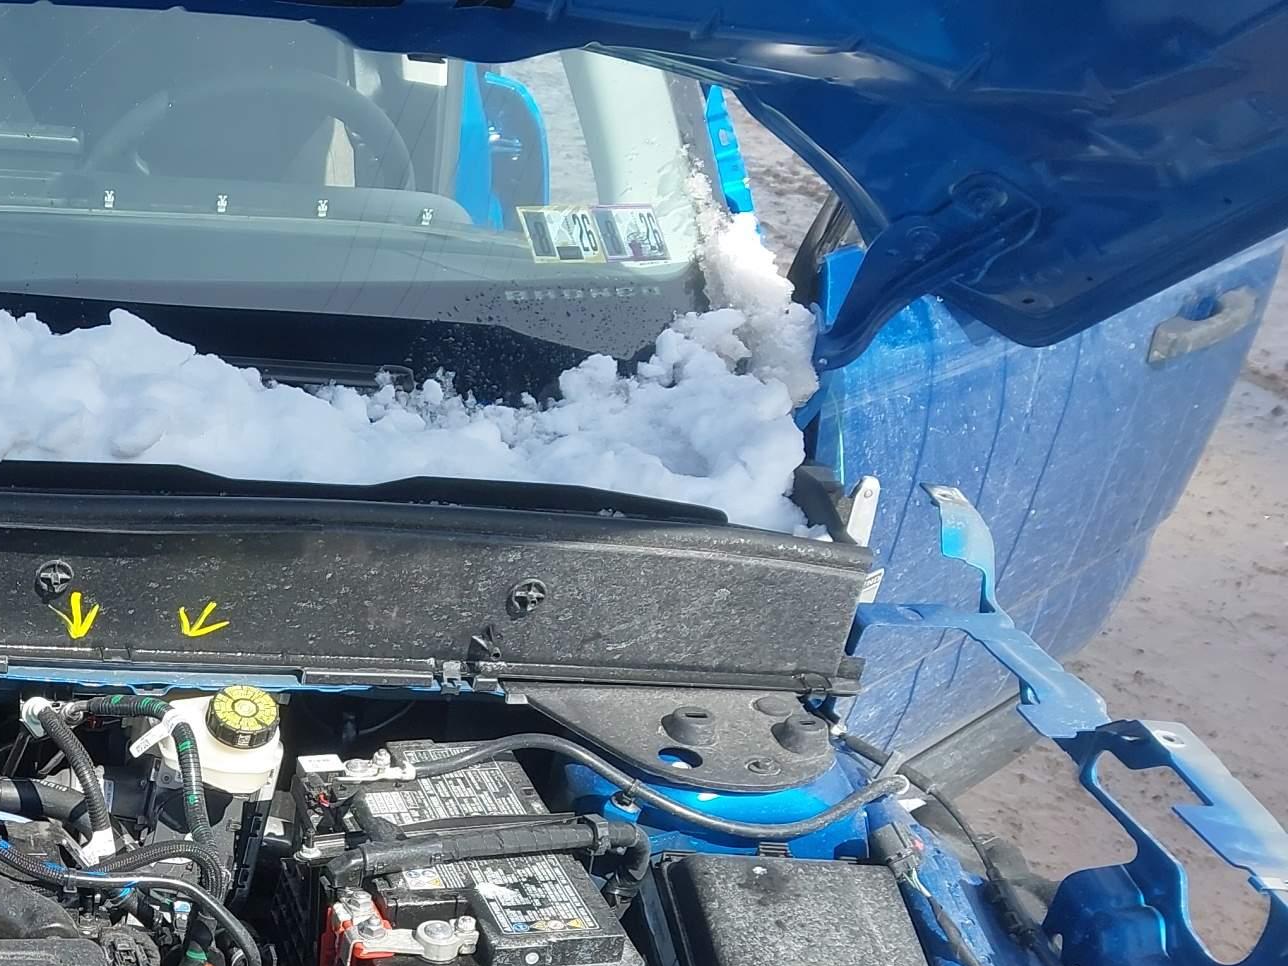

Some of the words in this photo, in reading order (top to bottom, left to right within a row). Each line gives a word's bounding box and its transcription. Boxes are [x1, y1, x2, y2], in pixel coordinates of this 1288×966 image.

[533, 221, 552, 255] 8
[571, 213, 599, 253] 26
[606, 219, 624, 255] 8
[638, 211, 663, 253] 26
